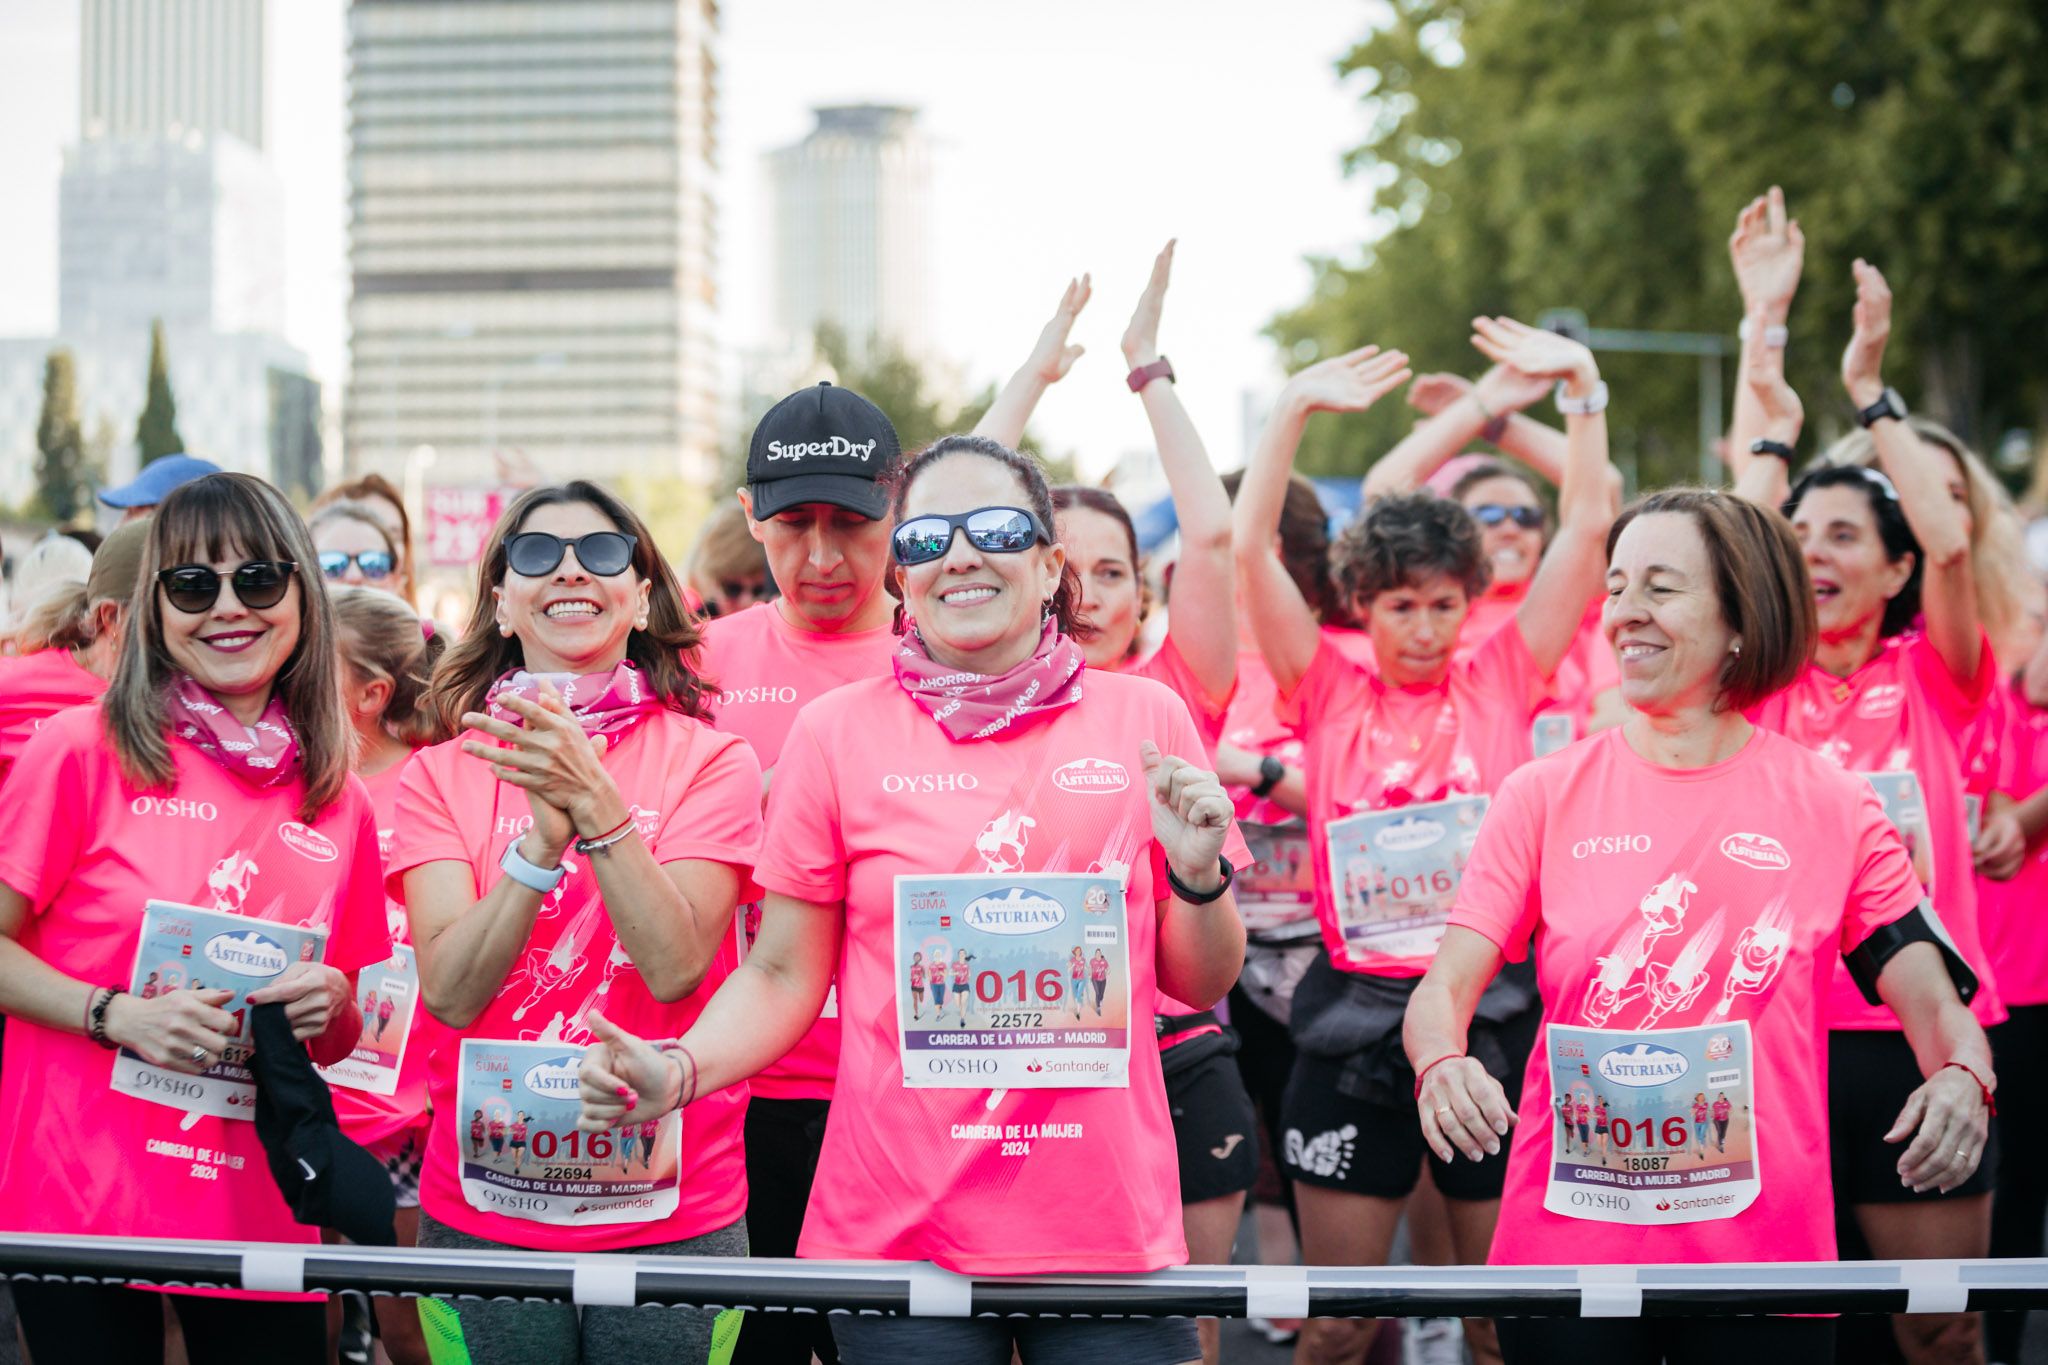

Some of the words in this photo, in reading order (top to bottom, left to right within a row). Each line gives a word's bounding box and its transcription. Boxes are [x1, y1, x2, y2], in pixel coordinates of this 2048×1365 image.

[882, 773, 979, 793] OYSHO
[1059, 772, 1125, 786] ASTURIANA
[131, 796, 217, 821] OYSHO
[1572, 834, 1652, 859] OYSHO
[1391, 870, 1453, 900] 016
[911, 898, 947, 910] SUMA
[1088, 889, 1107, 905] 20
[971, 905, 1060, 924] ASTURIANA
[208, 942, 284, 971] ASTURIANA
[975, 969, 1064, 1004] 016
[991, 1013, 1043, 1028] 22572
[928, 1034, 977, 1046] CARRERA
[981, 1033, 995, 1045] DE
[998, 1033, 1013, 1045] LA
[1016, 1032, 1055, 1045] MUJER
[1065, 1032, 1107, 1044] MADRID
[475, 1061, 510, 1073] SUMA
[928, 1058, 998, 1074] OYSHO
[1045, 1059, 1110, 1073] Santander
[1603, 1058, 1683, 1077] ASTURIANA
[137, 1070, 204, 1099] OYSHO
[530, 1071, 579, 1090] ASTUR
[951, 1124, 1003, 1140] CARRERA
[1006, 1125, 1020, 1139] DE
[1024, 1125, 1038, 1139] LA
[1041, 1123, 1083, 1138] MUJER
[1611, 1116, 1688, 1148] 016
[146, 1138, 194, 1160] CARRERA
[196, 1148, 212, 1162] DE
[214, 1151, 227, 1165] LA
[531, 1130, 613, 1159] 016
[1001, 1141, 1030, 1156] 2024
[190, 1164, 218, 1180] 2024
[543, 1167, 592, 1180] 22694
[1623, 1157, 1670, 1171] 18087
[485, 1170, 531, 1189] CARRERA
[533, 1181, 546, 1192] DE
[549, 1182, 563, 1193] LA
[566, 1183, 602, 1194] MUJER
[611, 1183, 654, 1194] MADRID
[1575, 1168, 1616, 1183] CARRERA
[1617, 1173, 1628, 1185] DE
[1629, 1175, 1643, 1186] LA
[1645, 1174, 1682, 1185] MUJER
[1689, 1167, 1731, 1183] MADRID
[482, 1188, 548, 1212] OYSHO
[590, 1198, 655, 1212] Santander
[1571, 1190, 1630, 1212] OYSHO
[1673, 1193, 1737, 1211] Santander
